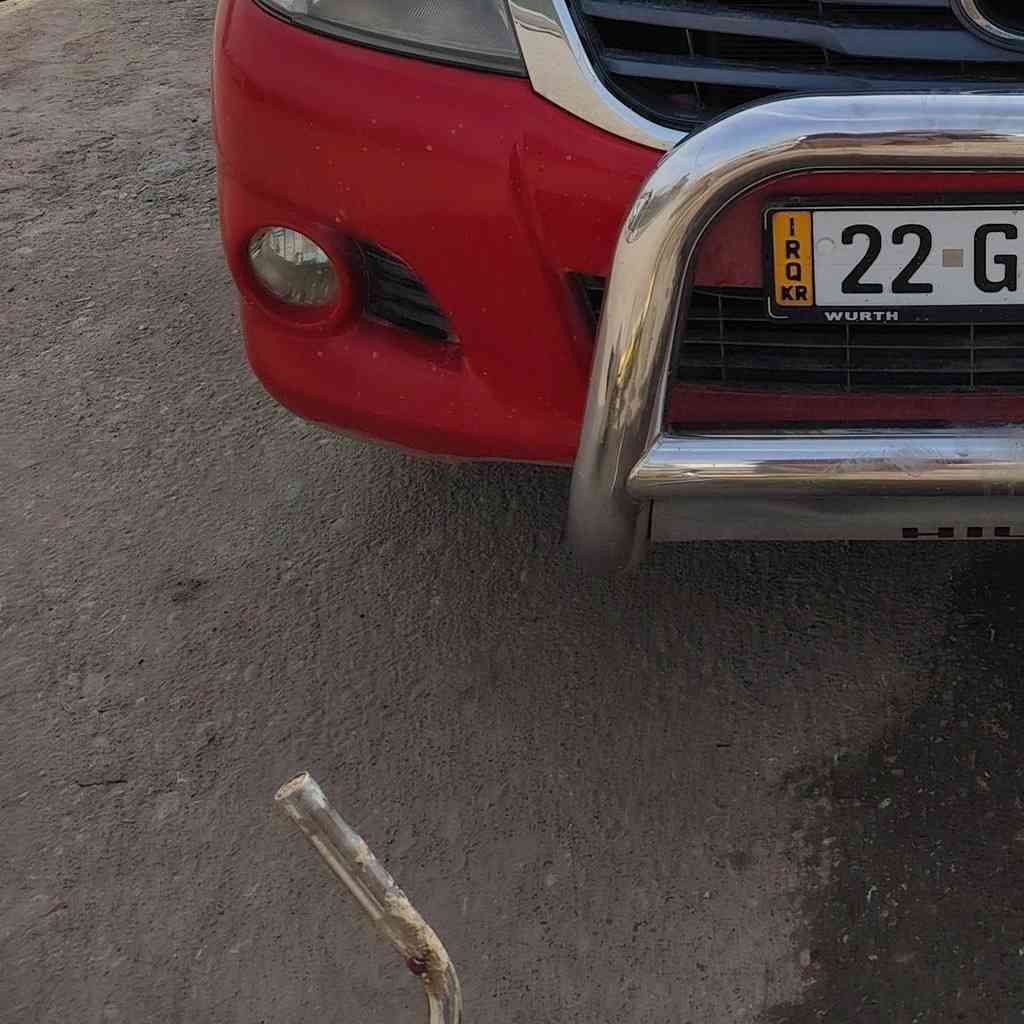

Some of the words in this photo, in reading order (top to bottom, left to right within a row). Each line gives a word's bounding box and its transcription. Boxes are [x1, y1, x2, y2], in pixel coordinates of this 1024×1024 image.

[840, 224, 934, 294] 22
[972, 223, 1018, 292] G
[824, 311, 899, 321] WURTH
